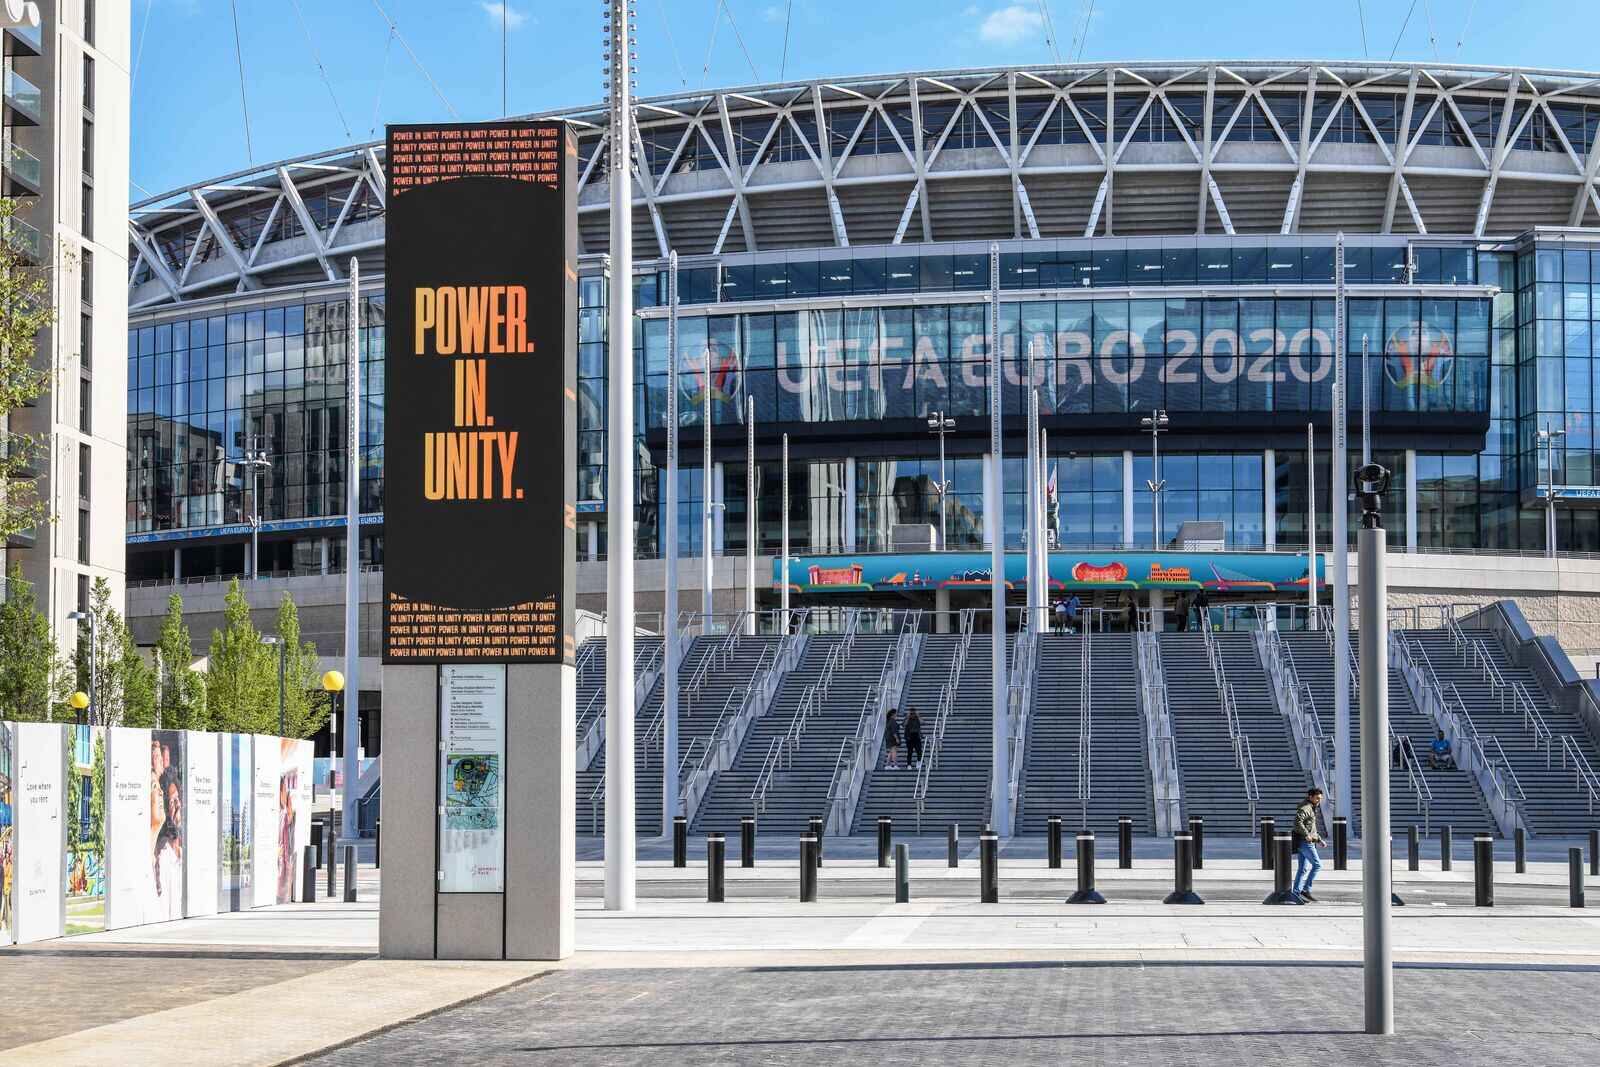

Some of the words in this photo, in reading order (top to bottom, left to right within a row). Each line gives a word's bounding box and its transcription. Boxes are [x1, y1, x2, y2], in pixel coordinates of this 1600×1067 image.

[393, 132, 413, 140] POWER
[415, 131, 421, 140] IN
[423, 131, 439, 140] UNITY
[441, 131, 461, 139] POWER
[463, 130, 469, 139] IN
[471, 130, 487, 139] UNITY
[489, 130, 509, 138] POWER
[511, 130, 517, 138] IN
[519, 129, 535, 138] UNITY
[537, 129, 557, 137] POWER
[393, 143, 399, 152] IN
[401, 143, 417, 152] UNITY
[418, 142, 438, 151] POWER
[440, 142, 446, 151] IN
[448, 142, 464, 151] UNITY
[465, 142, 485, 150] POWER
[487, 141, 492, 150] IN
[494, 141, 510, 150] UNITY
[512, 141, 532, 149] POWER
[533, 140, 539, 149] IN
[542, 140, 557, 149] UNITY
[393, 154, 413, 163] POWER
[415, 154, 421, 162] IN
[423, 154, 439, 162] UNITY
[441, 153, 461, 162] POWER
[463, 153, 469, 161] IN
[471, 153, 487, 161] UNITY
[489, 152, 509, 161] POWER
[511, 152, 517, 161] IN
[519, 152, 535, 160] UNITY
[537, 152, 557, 160] POWER
[393, 165, 399, 174] IN
[401, 165, 417, 174] UNITY
[418, 165, 438, 173] POWER
[440, 165, 446, 173] IN
[448, 164, 464, 173] UNITY
[465, 164, 485, 172] POWER
[487, 164, 492, 172] IN
[494, 164, 510, 172] UNITY
[512, 163, 532, 172] POWER
[533, 163, 539, 171] IN
[542, 163, 557, 171] UNITY
[393, 176, 413, 185] POWER
[415, 176, 421, 184] IN
[537, 174, 557, 182] POWER
[415, 286, 534, 354] POWER.
[777, 336, 947, 393] UEFA
[962, 329, 1147, 387] EURO
[1158, 328, 1332, 384] 2020
[454, 359, 494, 427] IN.
[424, 432, 524, 500] UNITY.
[390, 603, 410, 611] POWER
[412, 602, 418, 611] IN
[535, 602, 555, 610] POWER
[390, 614, 396, 623] IN
[398, 614, 414, 622] UNITY
[416, 614, 436, 622] POWER
[437, 614, 444, 622] IN
[445, 614, 461, 622] UNITY
[463, 614, 482, 622] POWER
[484, 613, 490, 622] IN
[492, 613, 508, 622] UNITY
[510, 613, 529, 622] POWER
[531, 613, 537, 622] IN
[539, 613, 555, 622] UNITY
[390, 625, 410, 634] POWER
[412, 625, 418, 634] IN
[420, 625, 436, 634] UNITY
[439, 625, 459, 633] POWER
[460, 625, 467, 633] IN
[468, 625, 485, 633] UNITY
[487, 625, 507, 633] POWER
[509, 624, 515, 633] IN
[517, 624, 533, 633] UNITY
[535, 624, 555, 633] POWER
[390, 636, 396, 645] IN
[398, 636, 414, 645] UNITY
[416, 636, 436, 645] POWER
[437, 636, 444, 645] IN
[445, 636, 461, 645] UNITY
[463, 636, 482, 644] POWER
[484, 636, 490, 644] IN
[492, 636, 508, 644] UNITY
[510, 636, 529, 644] POWER
[531, 636, 537, 644] IN
[539, 636, 555, 644] UNITY
[390, 648, 409, 656] POWER
[411, 648, 417, 656] IN
[418, 648, 434, 656] UNITY
[436, 647, 456, 656] POWER
[457, 647, 463, 656] IN
[464, 647, 480, 656] UNITY
[482, 647, 502, 656] POWER
[503, 647, 509, 656] IN
[510, 647, 526, 656] UNITY
[528, 647, 548, 655] POWER
[550, 647, 555, 655] IN
